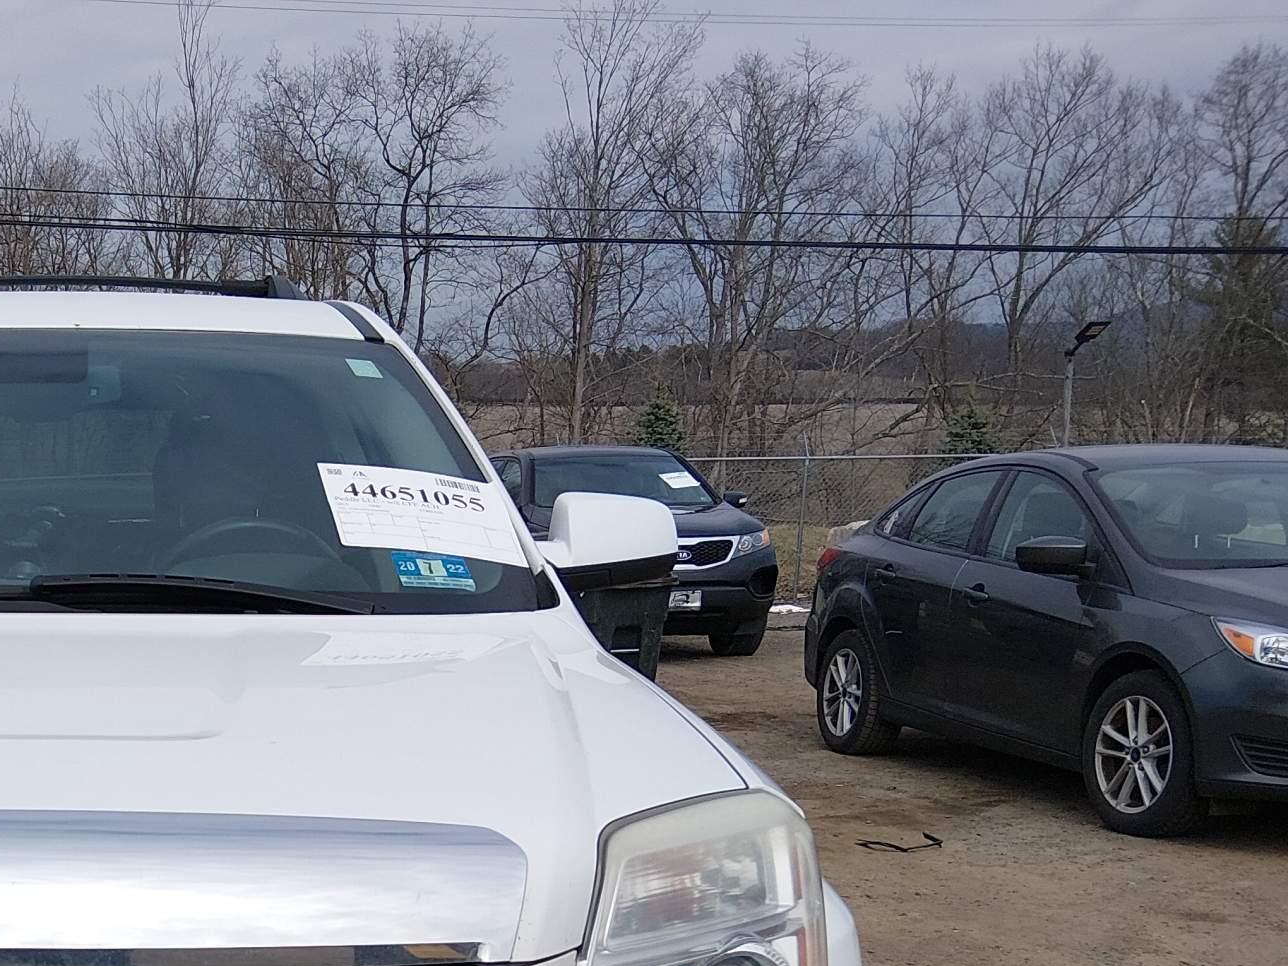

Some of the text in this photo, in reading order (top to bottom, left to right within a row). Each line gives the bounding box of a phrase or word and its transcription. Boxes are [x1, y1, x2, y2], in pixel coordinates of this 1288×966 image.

[343, 482, 486, 513] 44651055
[398, 561, 466, 575] 20 7 22
